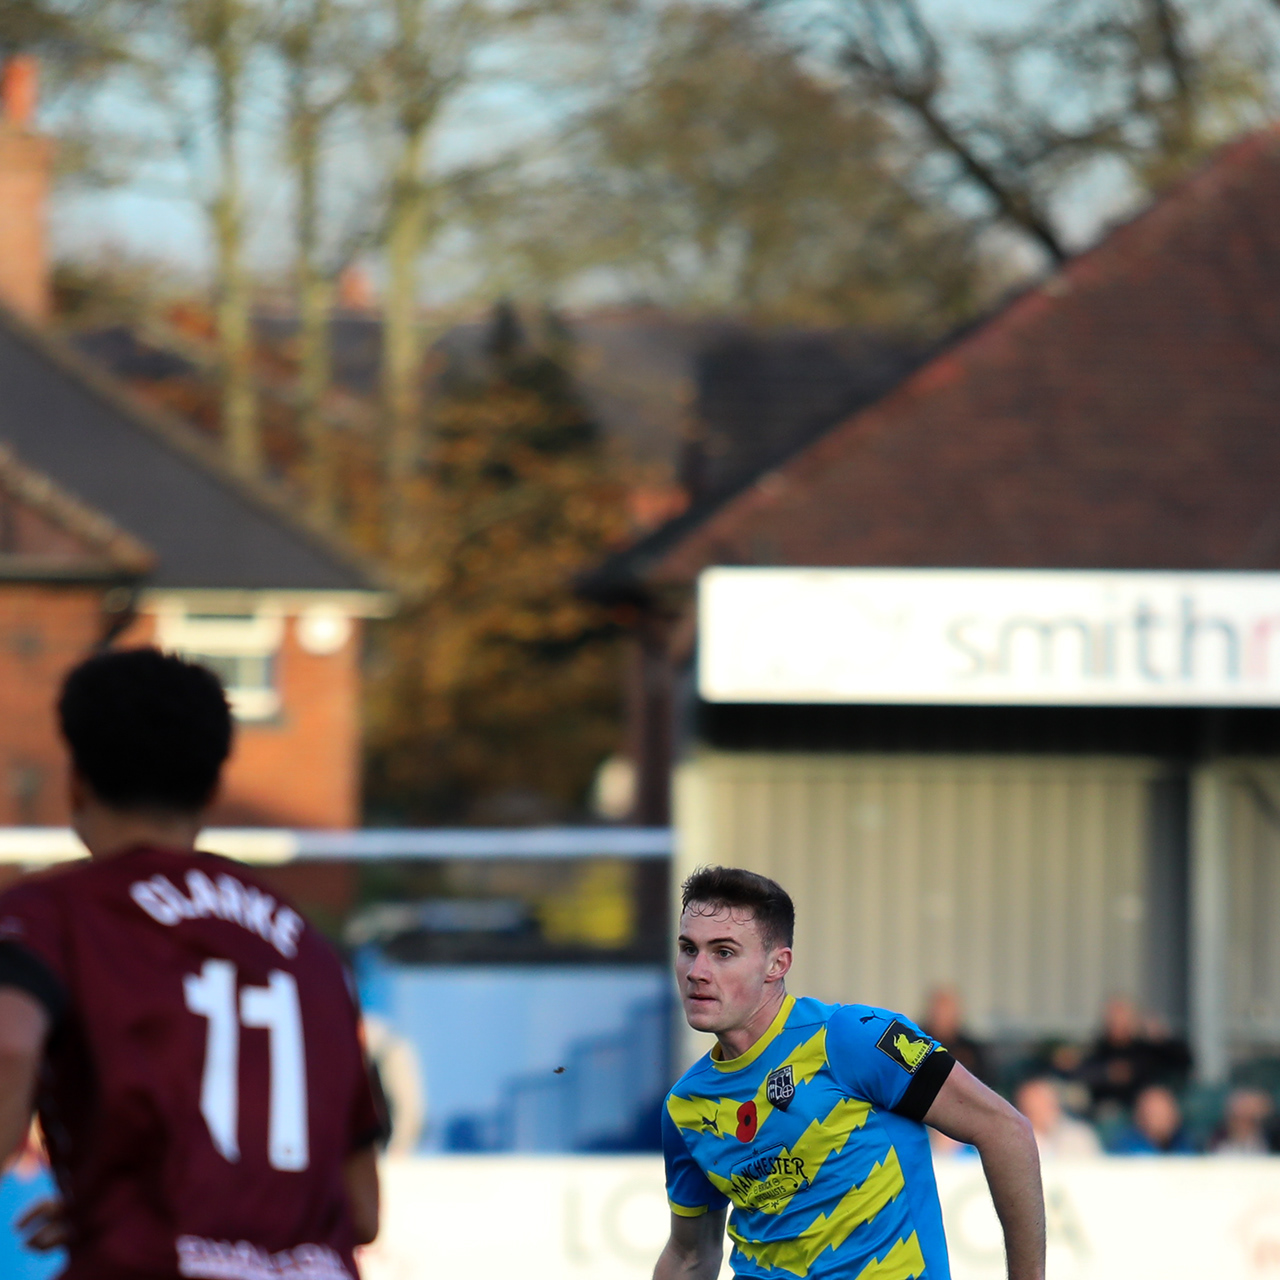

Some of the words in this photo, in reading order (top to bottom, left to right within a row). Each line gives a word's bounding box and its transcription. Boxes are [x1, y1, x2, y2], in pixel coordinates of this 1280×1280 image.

[129, 868, 306, 961] CLARKE
[182, 957, 310, 1173] 11
[731, 1157, 809, 1205] MANCHESTER
